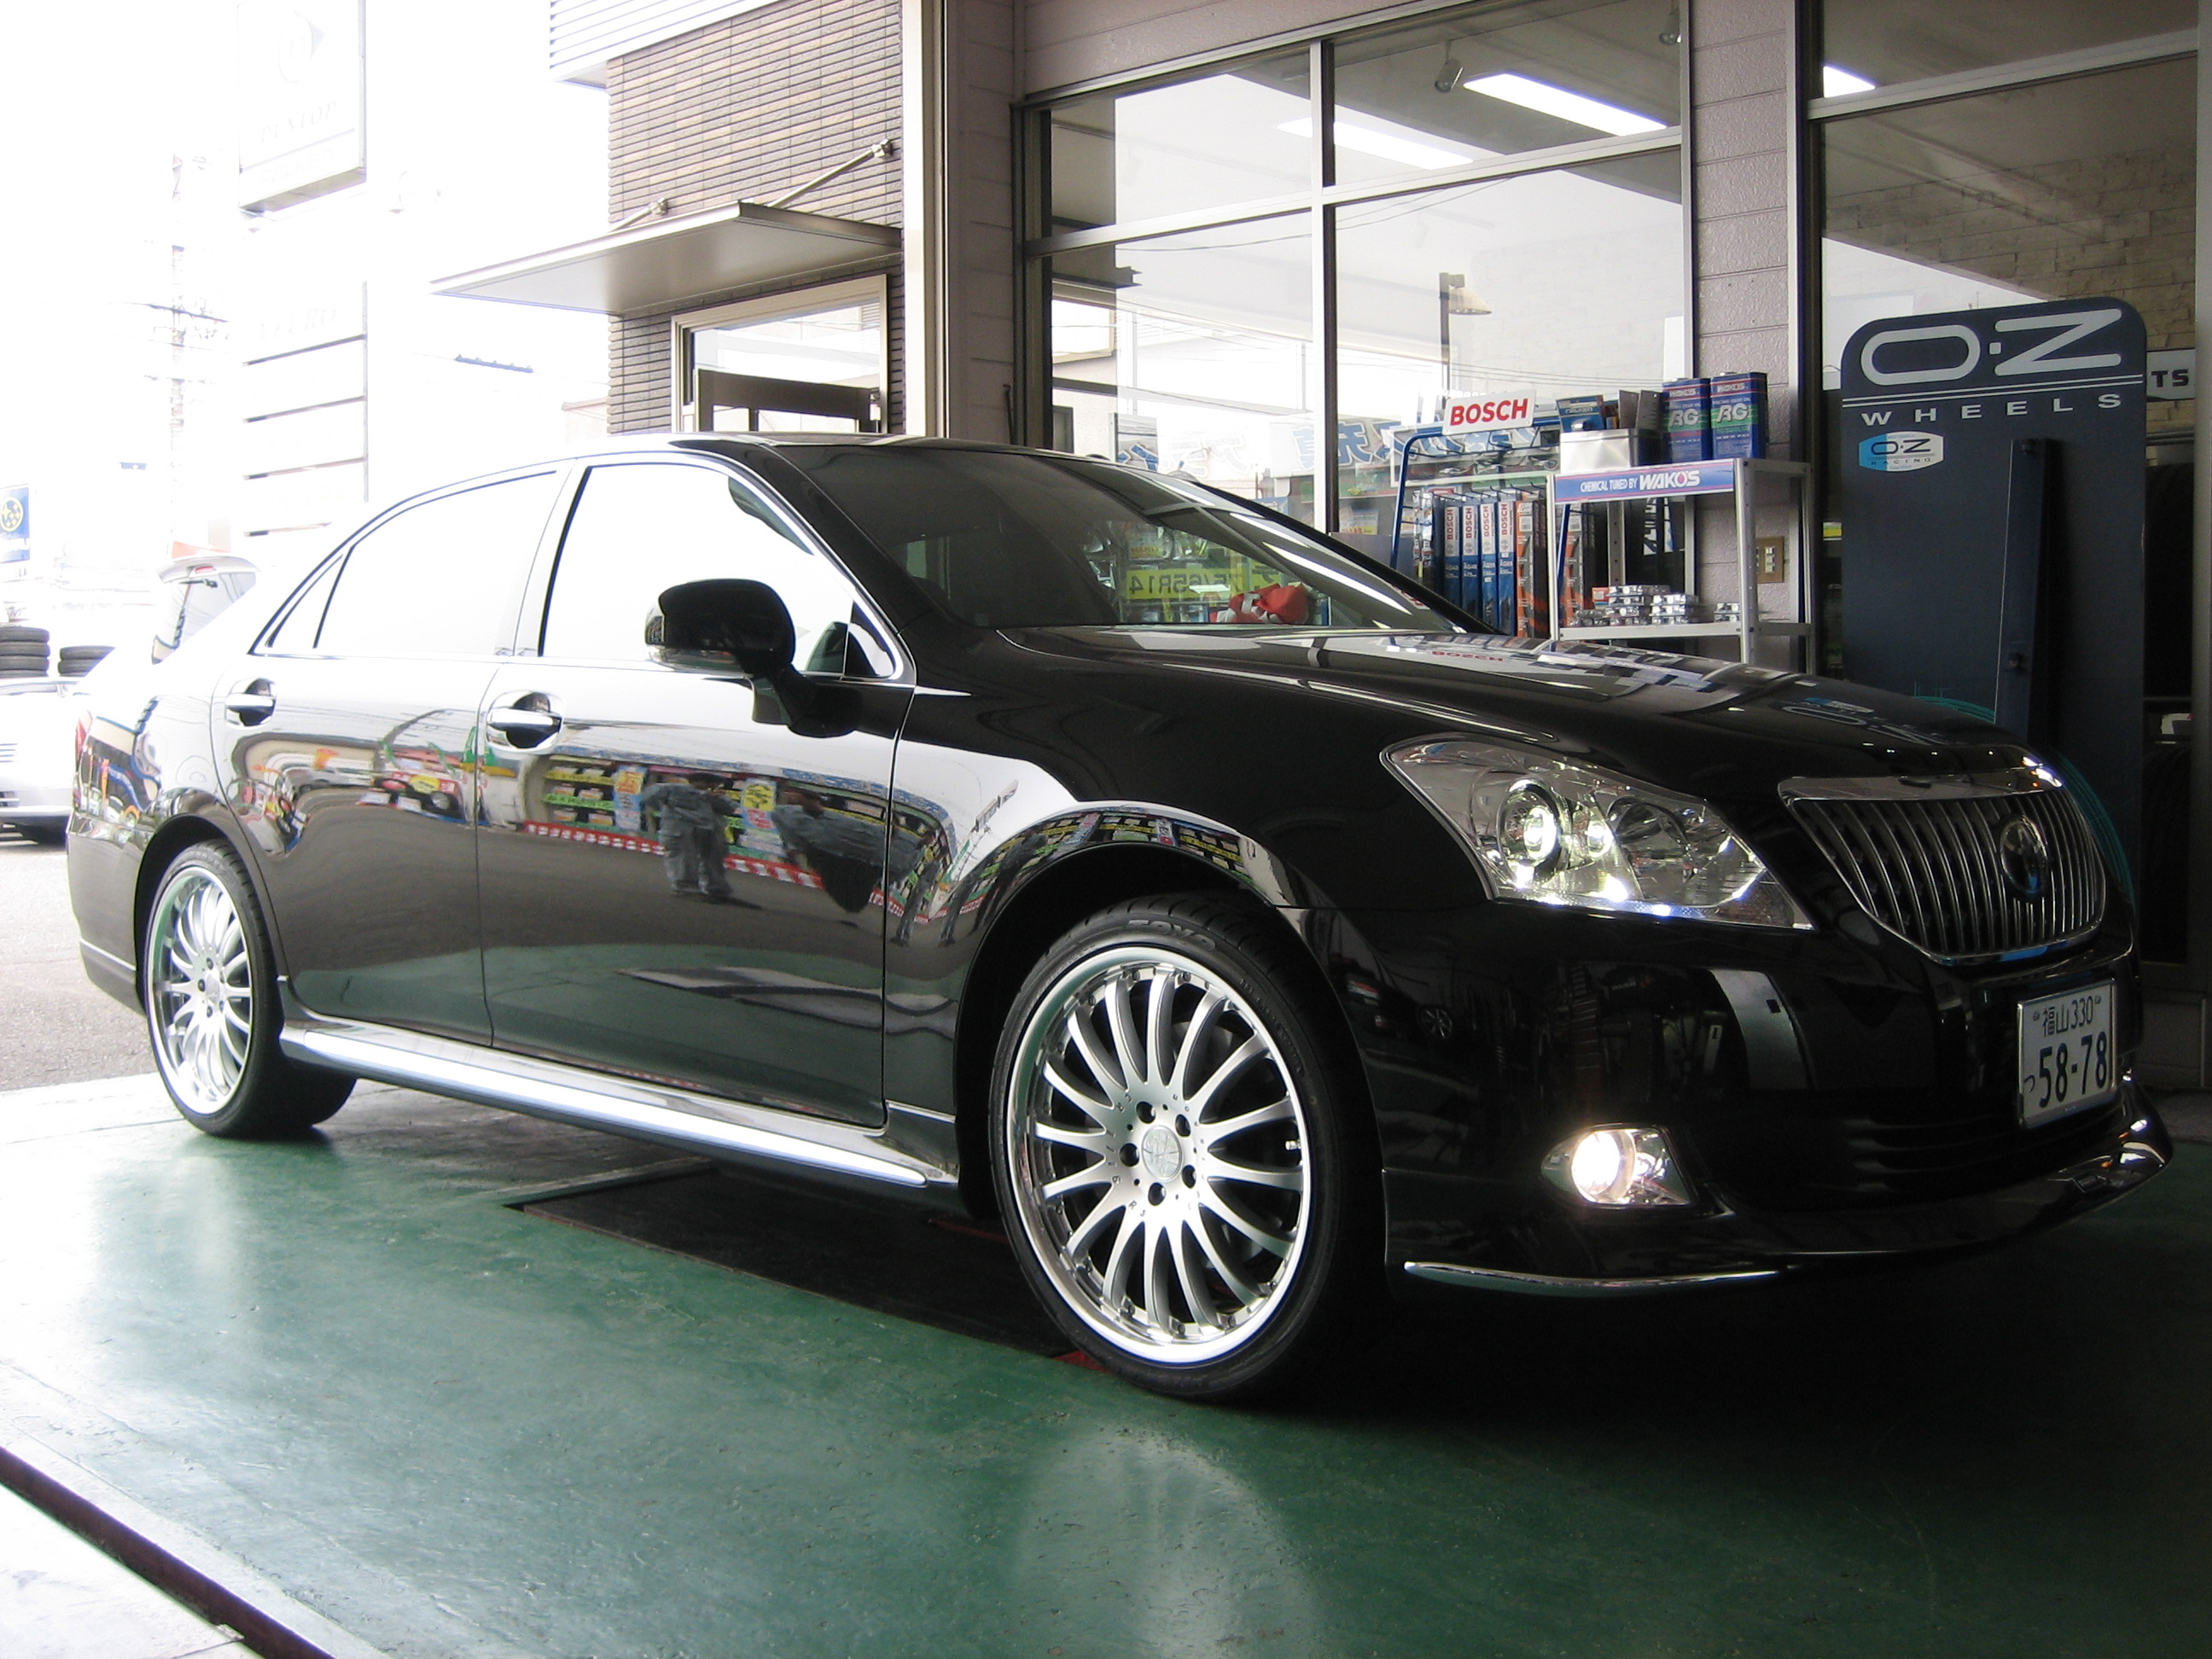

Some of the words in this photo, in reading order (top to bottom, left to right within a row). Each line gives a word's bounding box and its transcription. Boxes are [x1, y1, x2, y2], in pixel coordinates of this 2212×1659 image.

[1449, 398, 1528, 426] BOSCH
[1861, 393, 2122, 427] WHEELS
[1871, 457, 1931, 466] RACING
[1628, 477, 1639, 489] BY
[1128, 919, 1216, 951] TOYO
[2023, 1074, 2035, 1092] つ
[2038, 1031, 2108, 1109] 58-78
